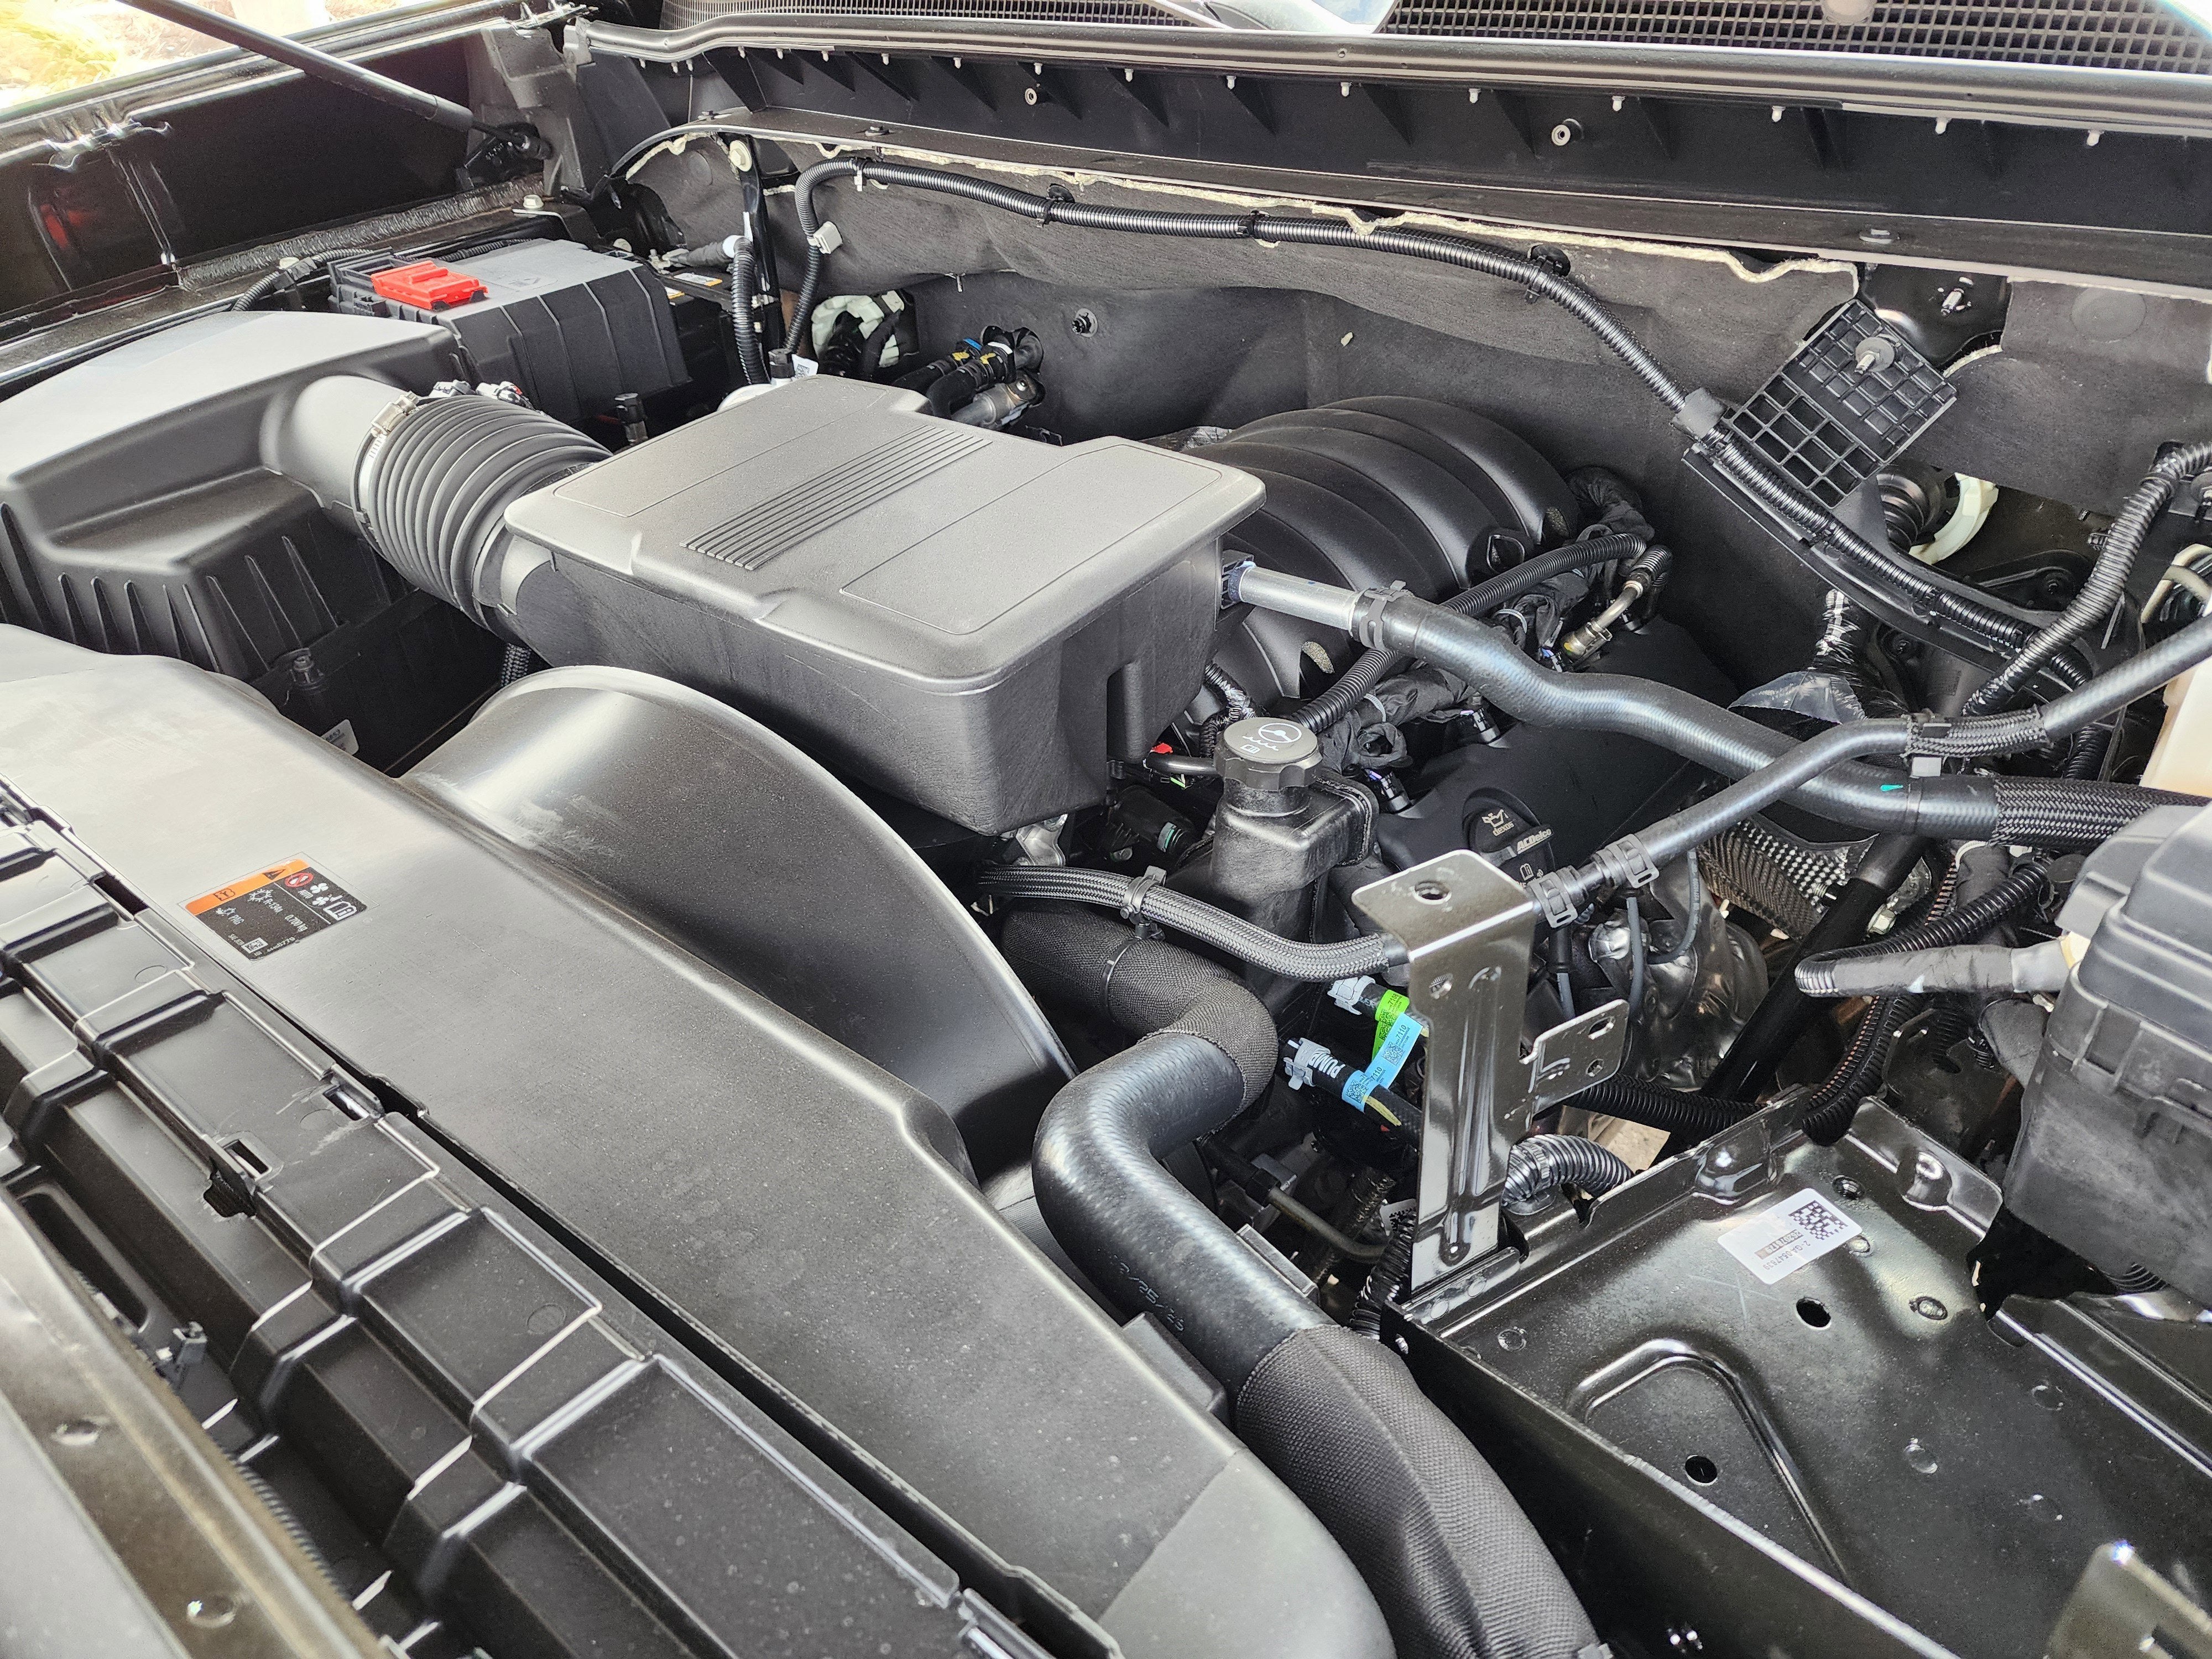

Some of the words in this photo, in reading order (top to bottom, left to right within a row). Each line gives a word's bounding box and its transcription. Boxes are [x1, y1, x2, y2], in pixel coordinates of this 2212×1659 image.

[1493, 821, 1515, 836] dexos
[1517, 828, 1552, 852] ACDelco
[298, 889, 314, 899] AUTO
[263, 898, 283, 913] R-134a
[228, 914, 244, 925] PAG
[1308, 1052, 1346, 1079] PUMP
